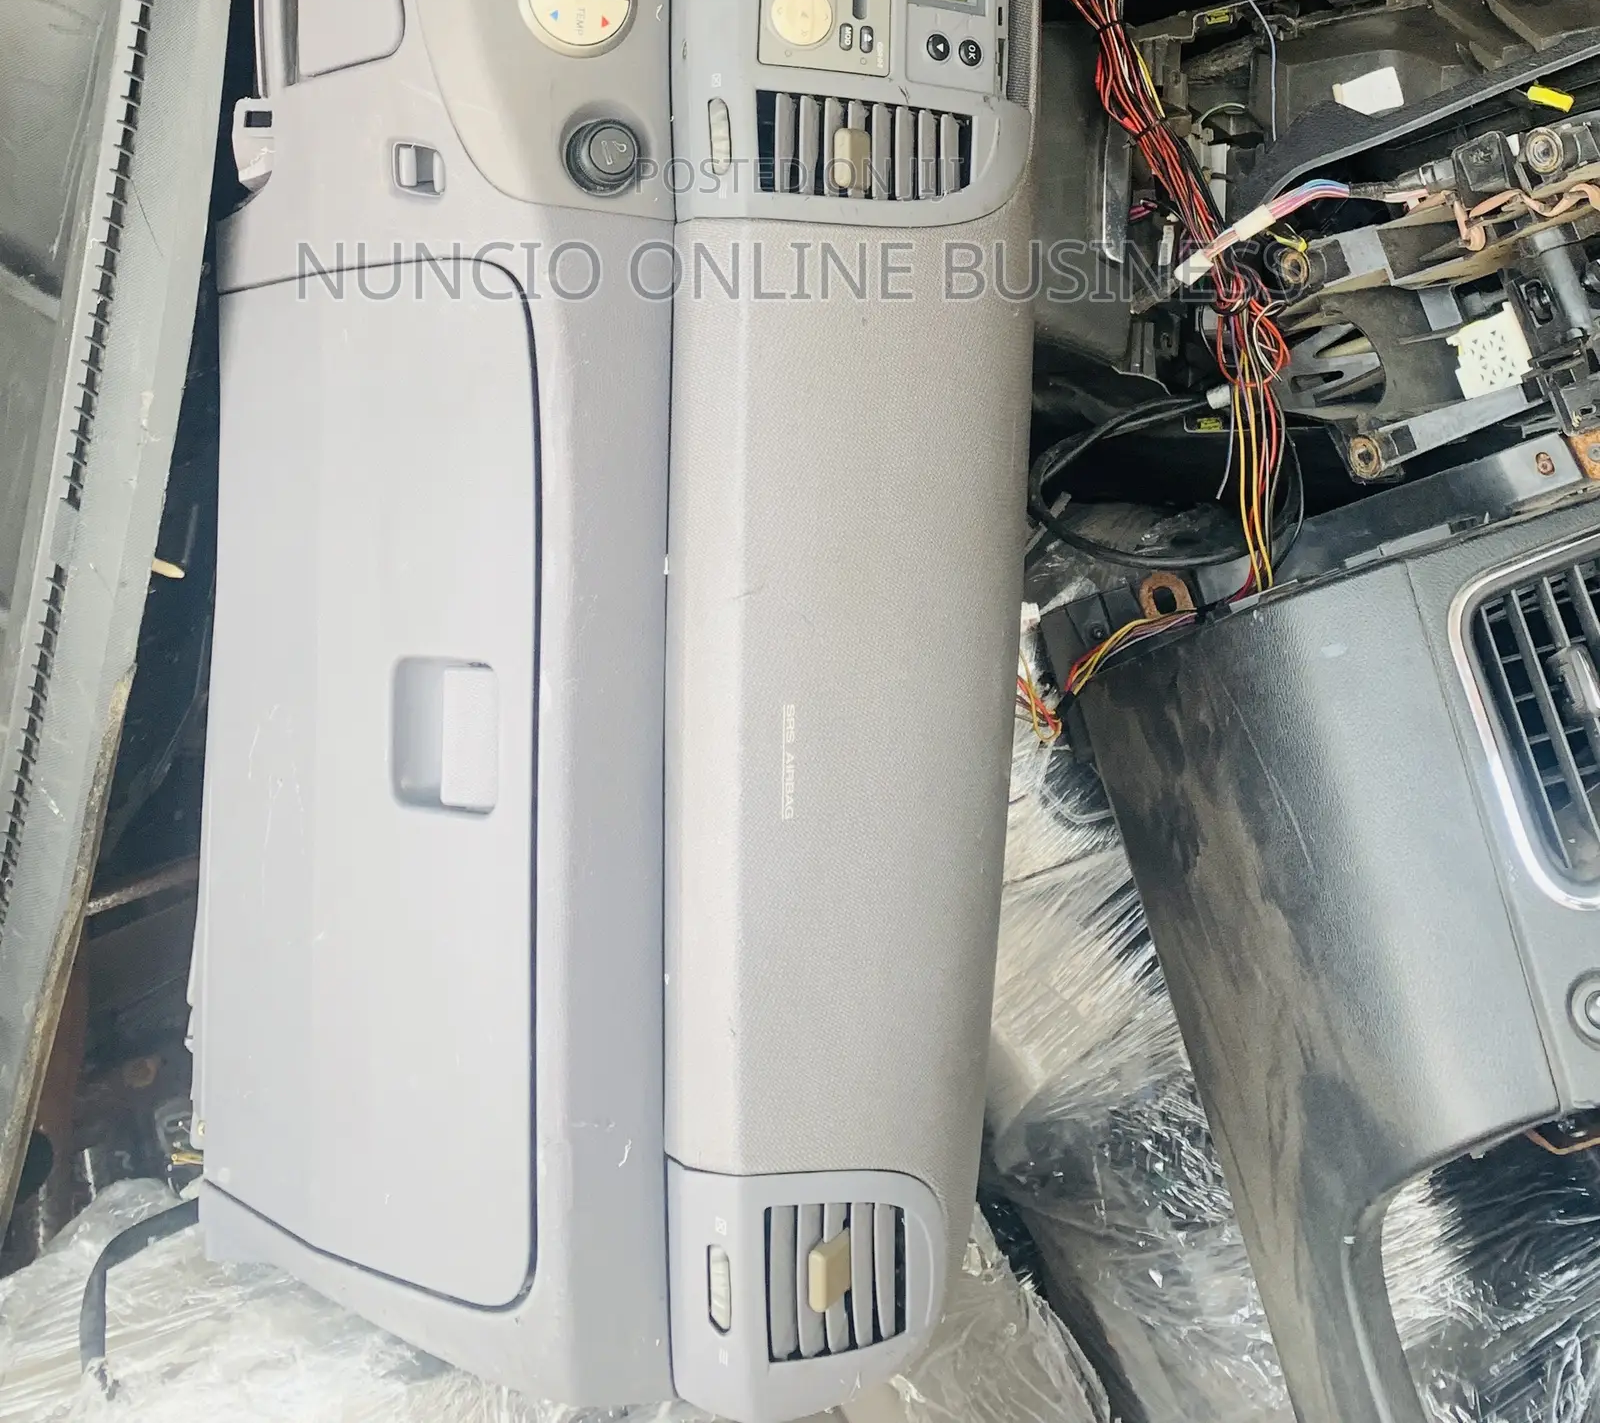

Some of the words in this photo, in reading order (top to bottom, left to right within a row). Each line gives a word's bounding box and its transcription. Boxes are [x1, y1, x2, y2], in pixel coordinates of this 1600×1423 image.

[575, 7, 586, 36] TEMP
[843, 27, 853, 46] MOD
[967, 44, 976, 59] OK
[785, 704, 796, 743] SRS
[784, 750, 795, 820] AIRBAG
